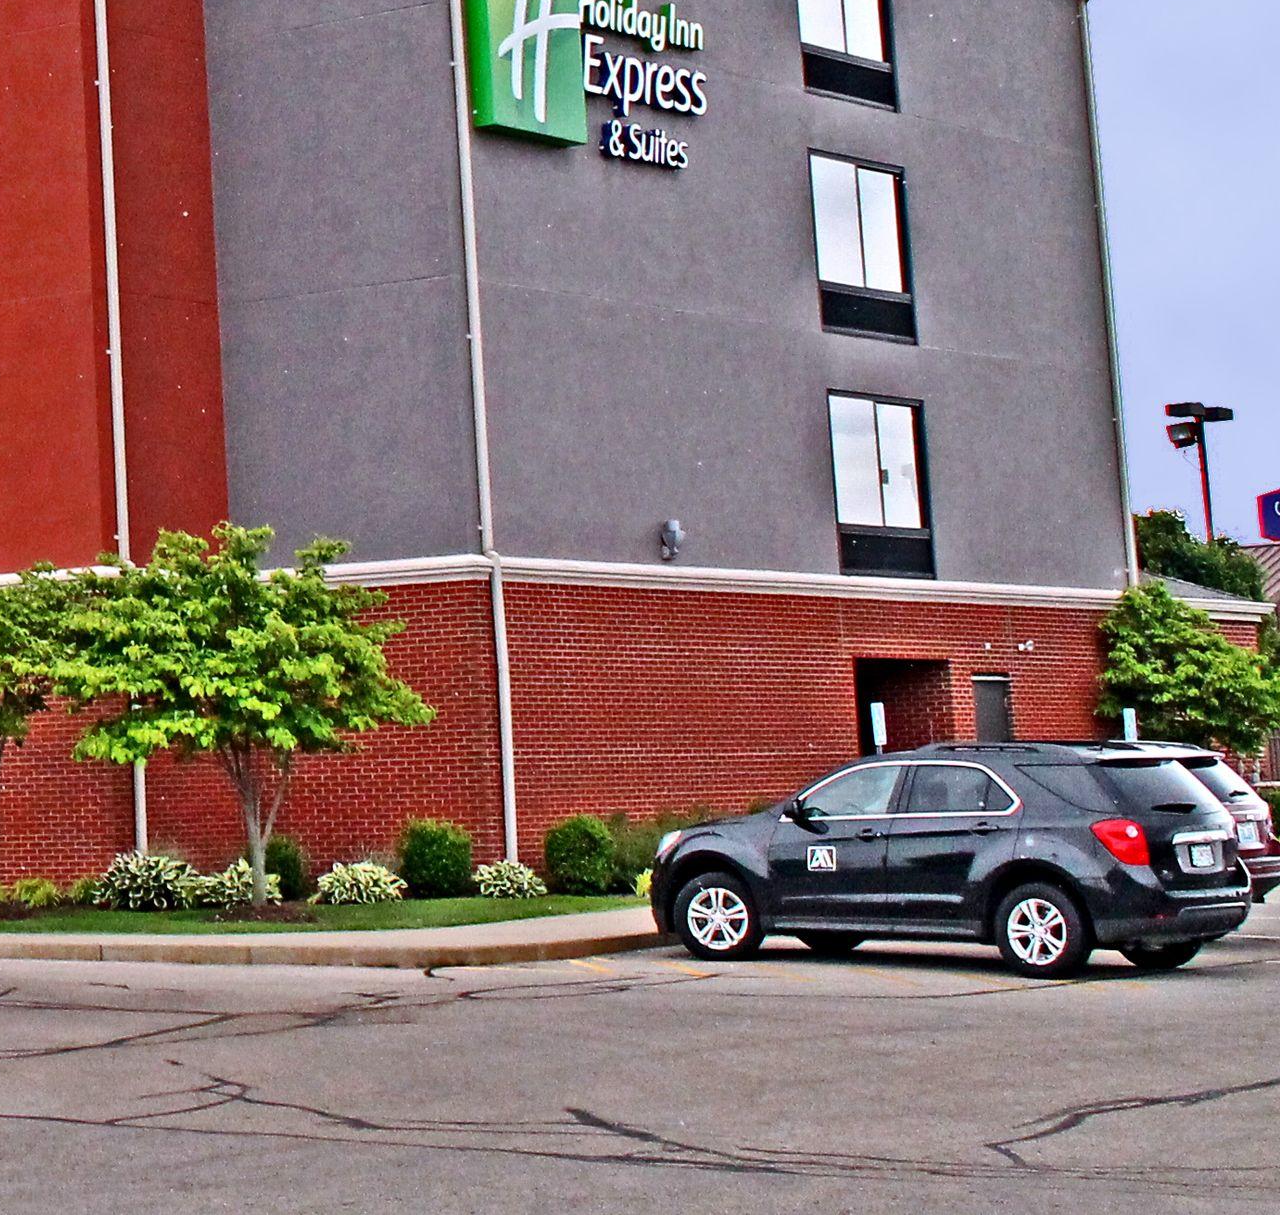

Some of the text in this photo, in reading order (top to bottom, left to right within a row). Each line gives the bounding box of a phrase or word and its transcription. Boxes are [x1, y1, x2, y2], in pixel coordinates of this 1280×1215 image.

[669, 3, 703, 50] Inn
[584, 34, 708, 117] Express
[609, 119, 689, 169] & Suites
